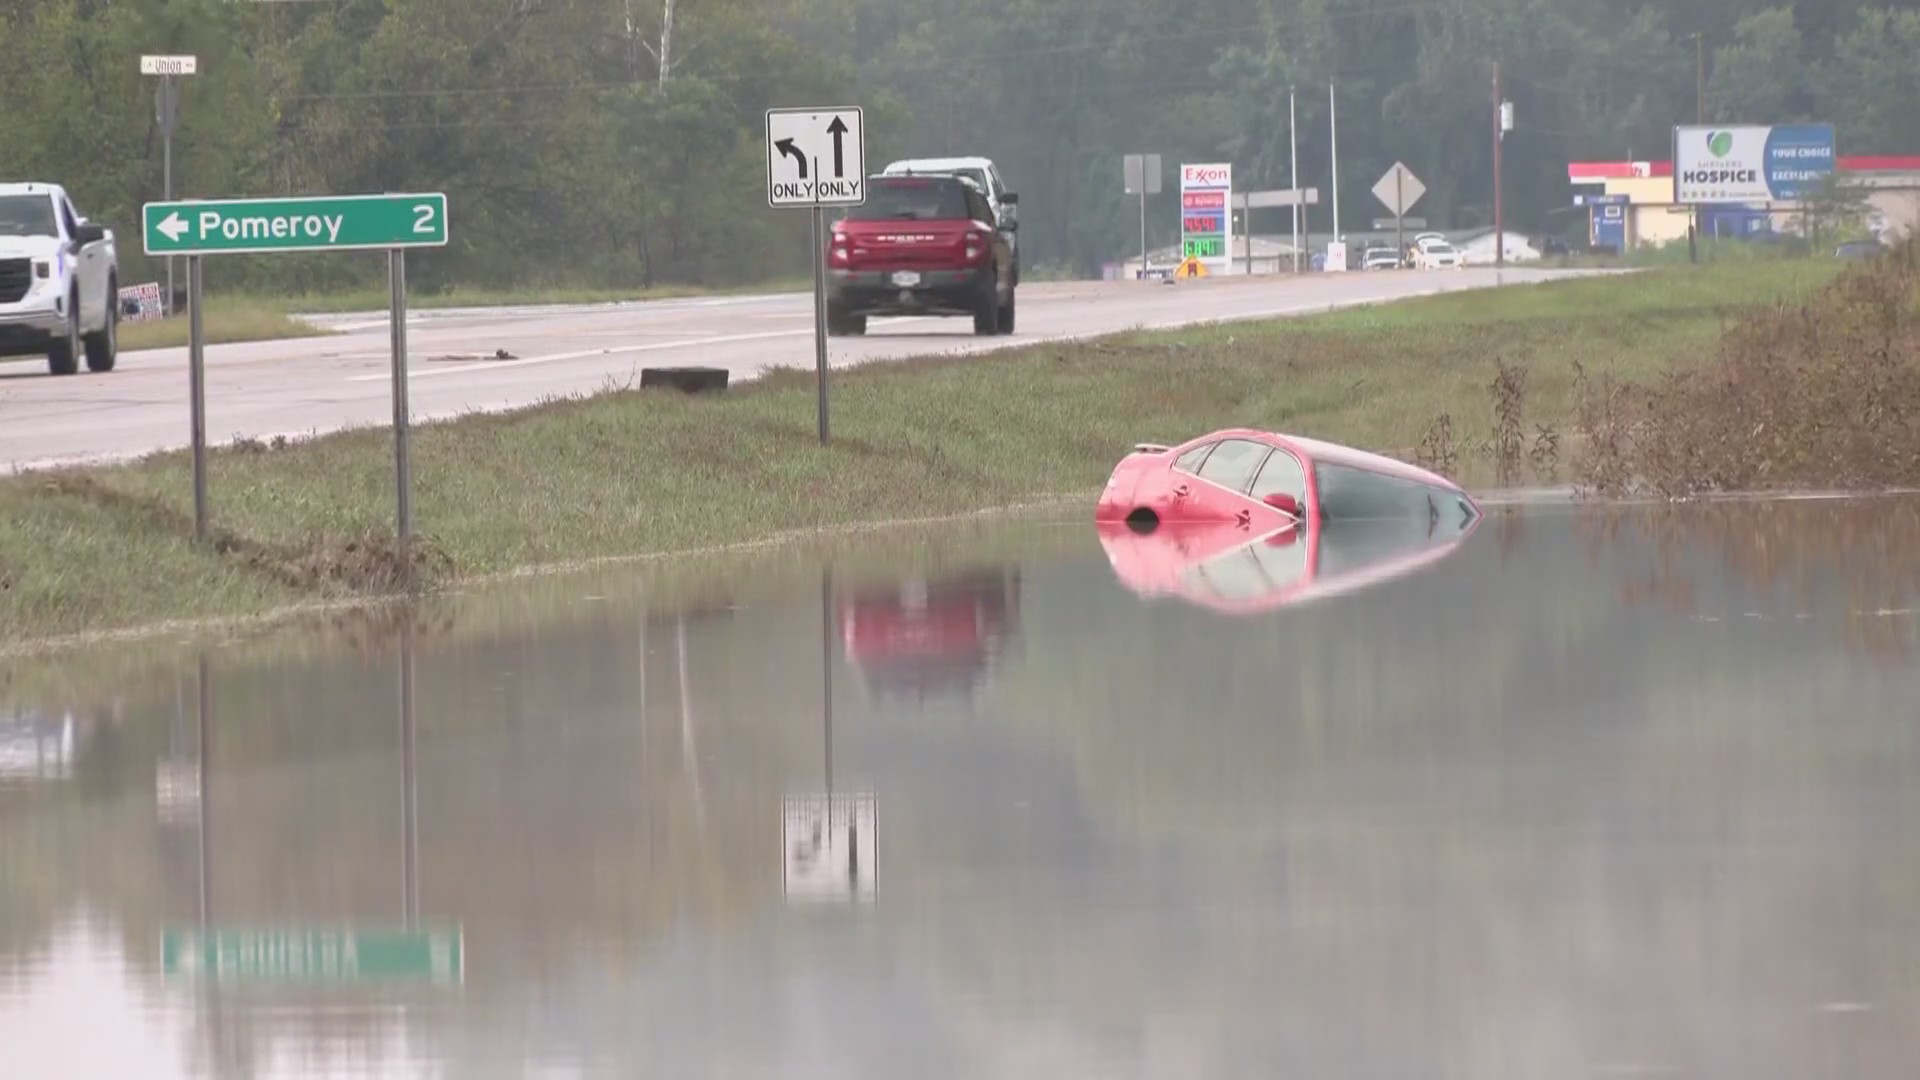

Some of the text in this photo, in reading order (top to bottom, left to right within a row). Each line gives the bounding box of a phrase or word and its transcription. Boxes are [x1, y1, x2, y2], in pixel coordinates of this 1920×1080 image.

[155, 57, 182, 73] Union
[1185, 168, 1228, 185] Exxon
[1683, 169, 1757, 184] HOSPICE
[774, 180, 859, 198] ONLY ONLY
[199, 204, 436, 243] Pomeroy 2
